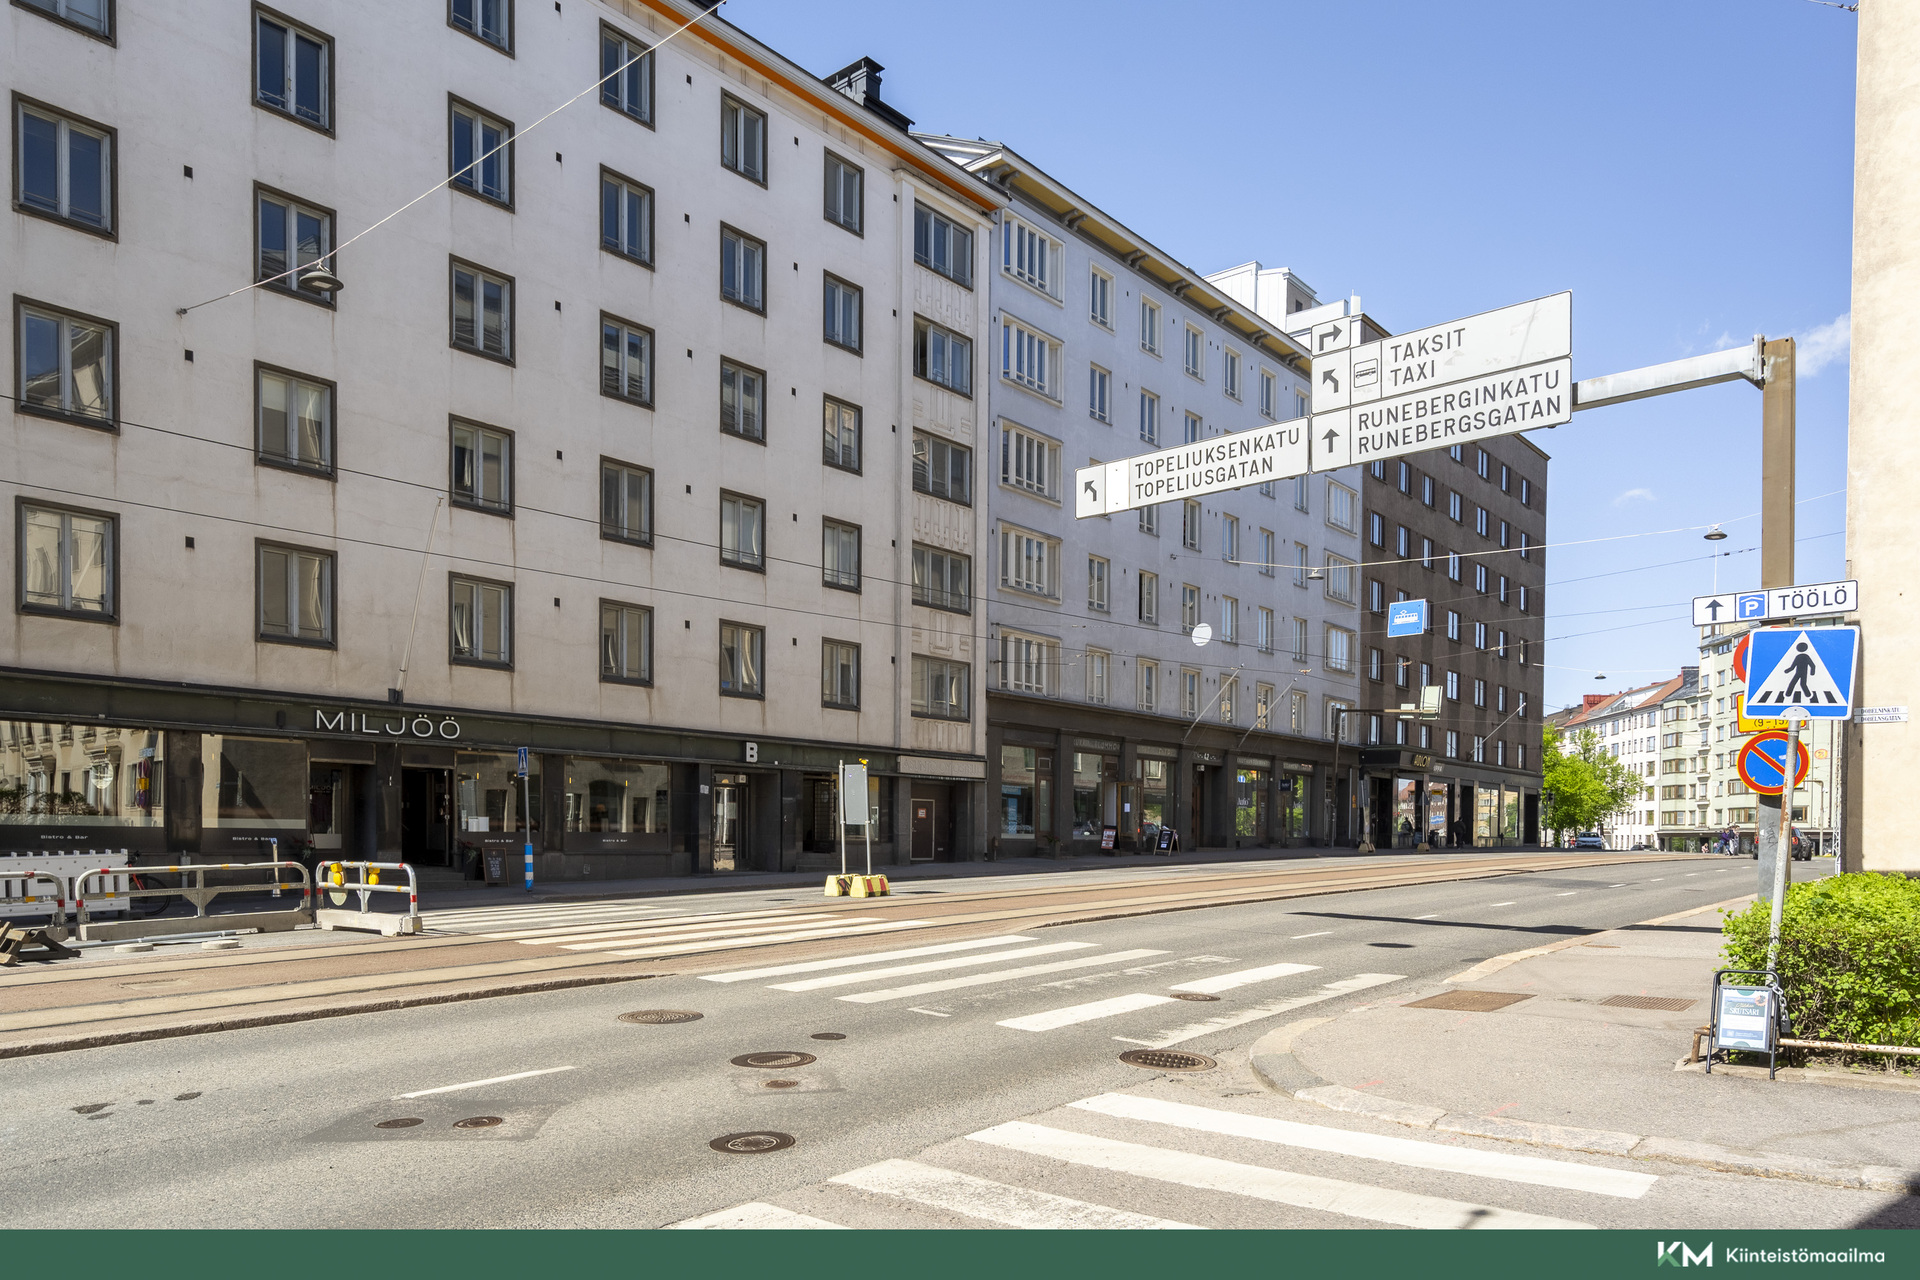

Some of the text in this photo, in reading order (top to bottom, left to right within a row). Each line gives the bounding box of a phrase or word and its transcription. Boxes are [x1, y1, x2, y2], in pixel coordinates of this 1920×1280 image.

[1390, 327, 1466, 363] TAKSIT
[1390, 360, 1435, 387] TAXI
[1358, 369, 1560, 432] RUNEBERGINKATU
[1358, 395, 1561, 455] RUNEBERGSGATAN
[1134, 427, 1300, 479] TOPELIUKSENKATU
[1134, 456, 1273, 500] TOPELIUSGATAN
[1745, 585, 1847, 617] P TÖÖLÖ
[316, 709, 460, 739] MILJÖÖ
[746, 741, 758, 763] B
